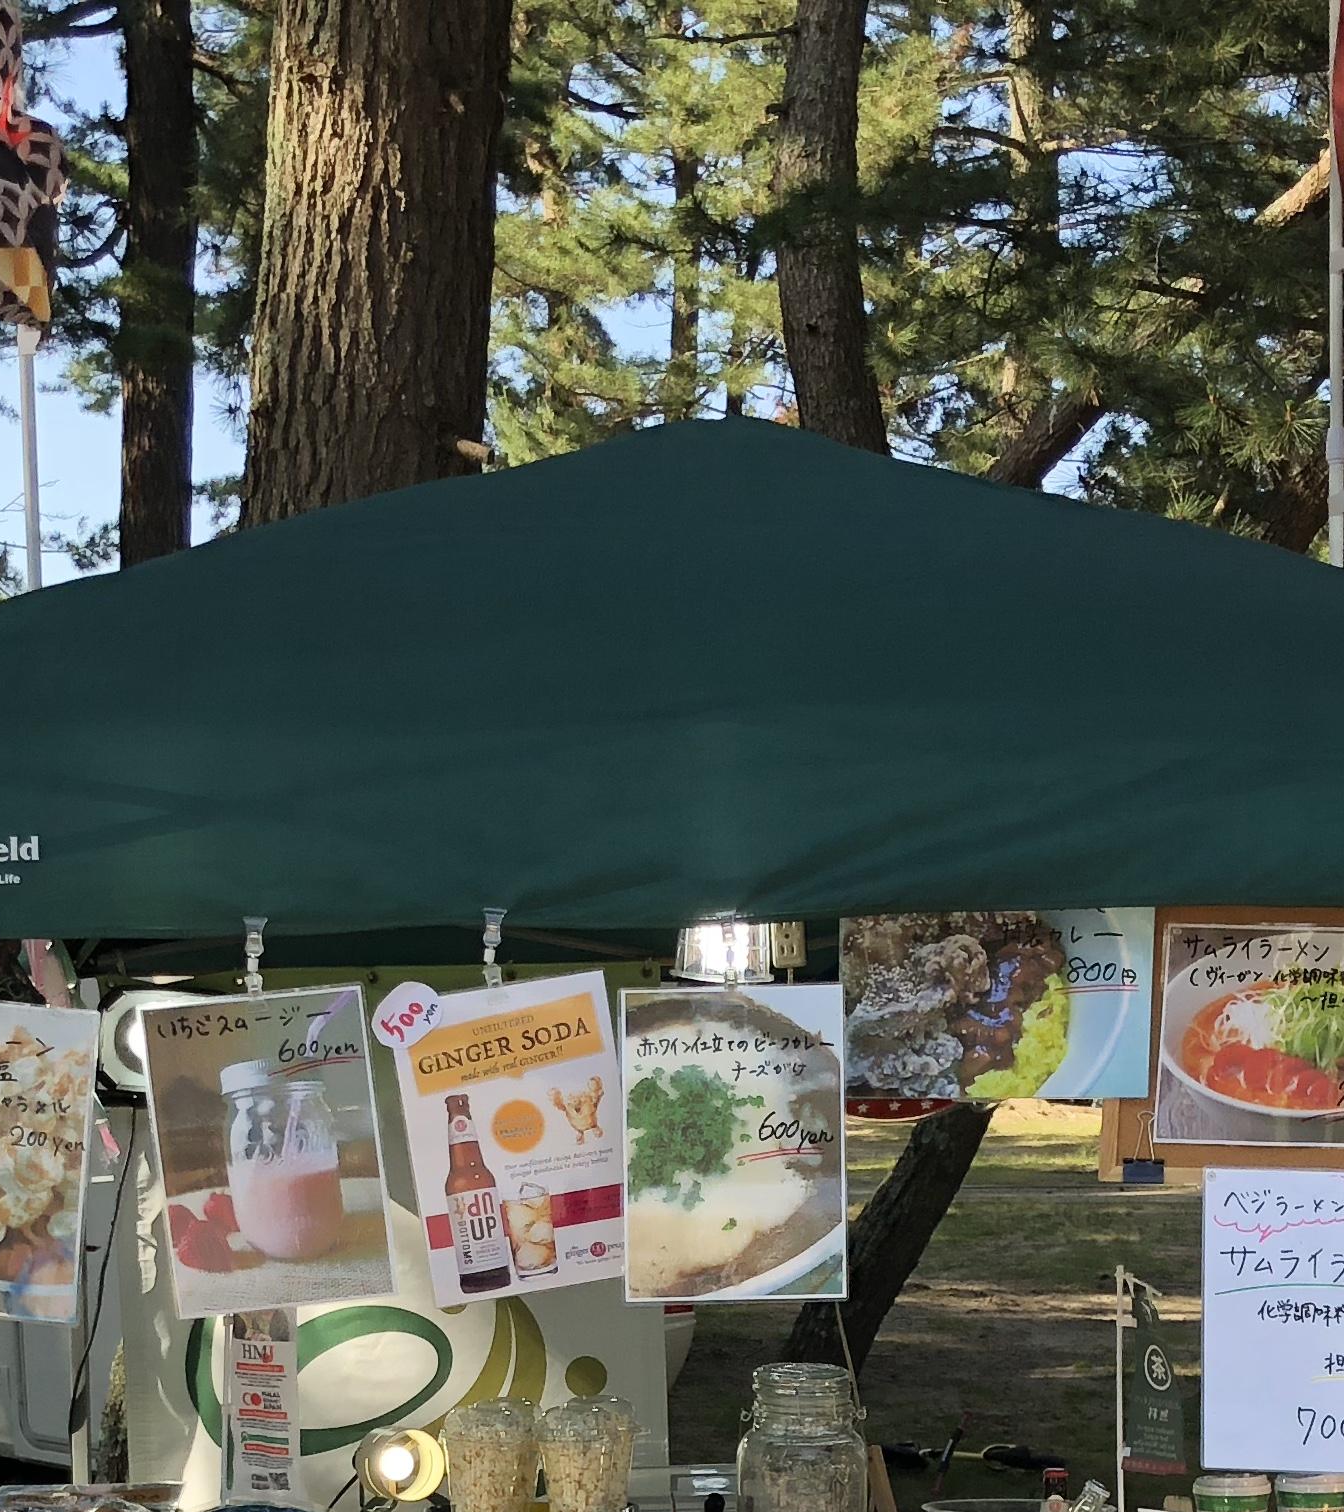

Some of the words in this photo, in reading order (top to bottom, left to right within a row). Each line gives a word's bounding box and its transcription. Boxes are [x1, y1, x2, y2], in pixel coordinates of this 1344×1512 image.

[1183, 935, 1330, 962] サムライラーメン
[381, 1002, 424, 1043] 500
[422, 1003, 438, 1025] yen
[472, 1015, 535, 1036] UNFILTERED
[278, 1038, 319, 1063] 600
[323, 1043, 360, 1061] yen
[418, 1036, 516, 1075] GINGER
[521, 1017, 591, 1051] SODA
[732, 1061, 806, 1081] チーズがけ
[10, 1126, 47, 1148] 200
[53, 1137, 85, 1157] yen
[759, 1111, 800, 1141] 600
[800, 1128, 834, 1153] yen
[1223, 1189, 1344, 1216] ベジラーメン
[470, 1216, 497, 1241] UP
